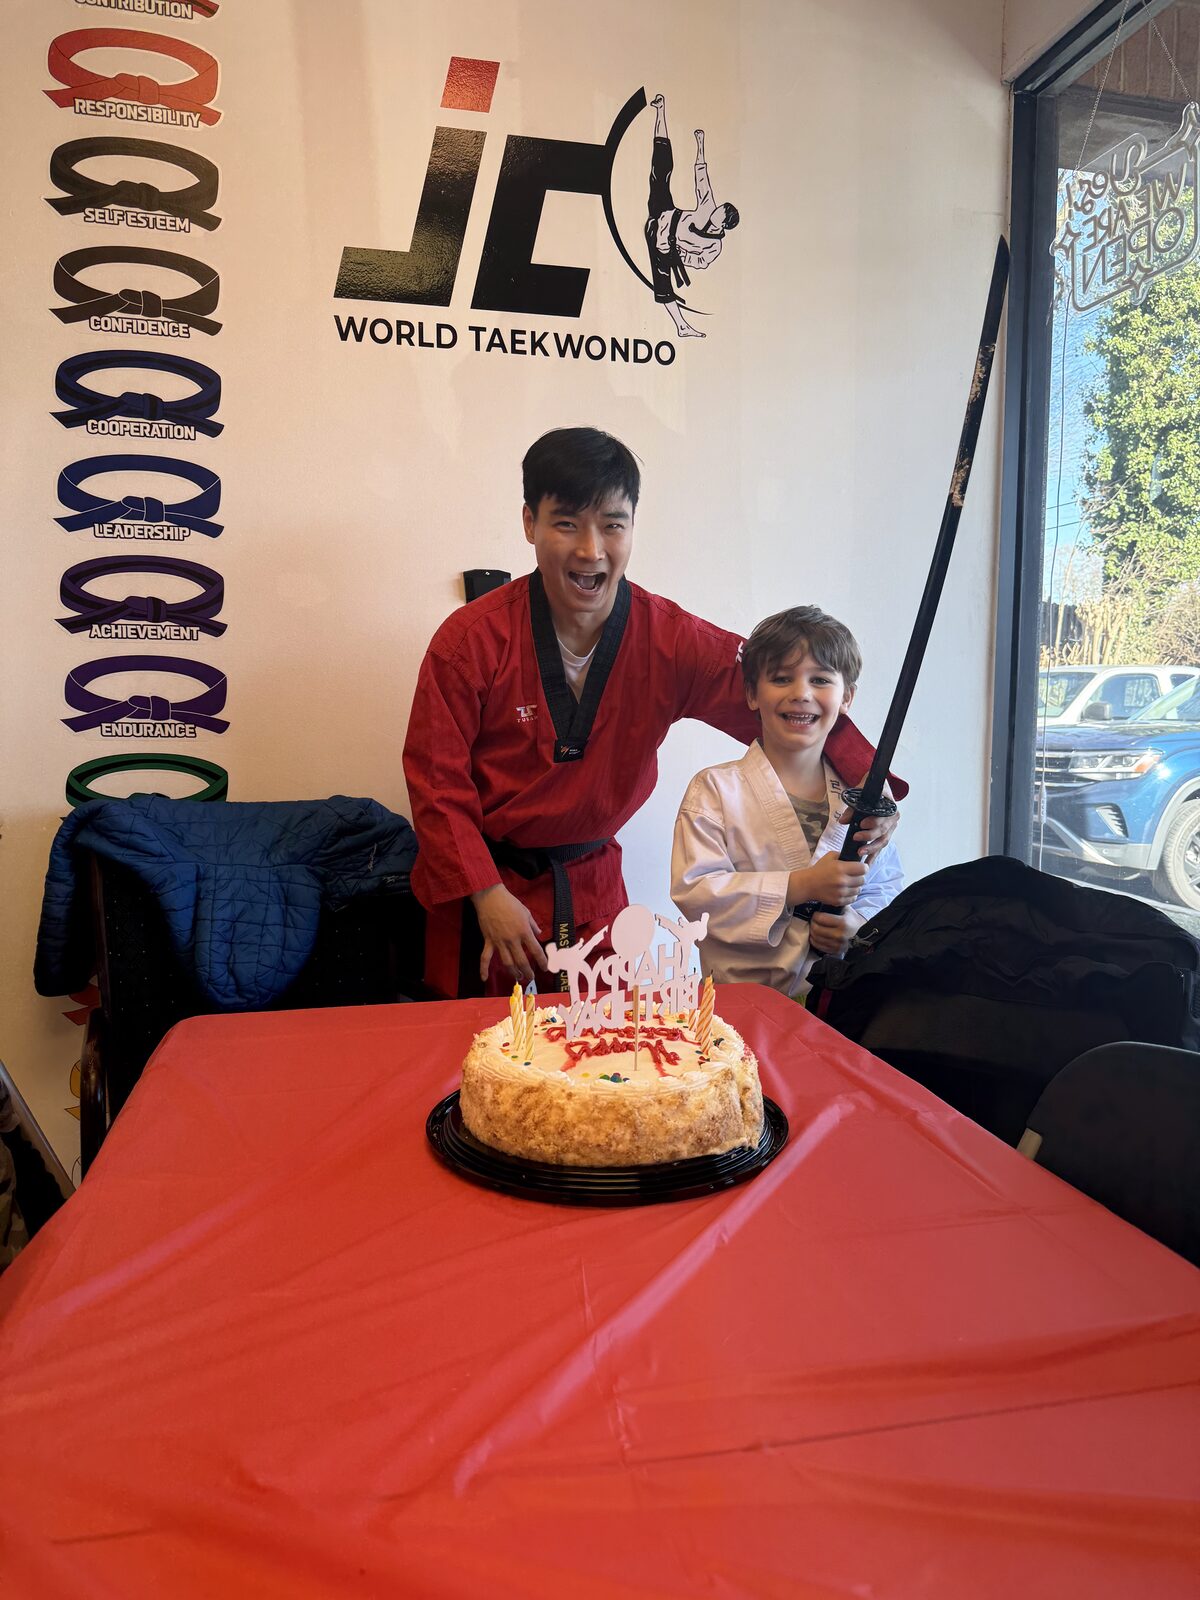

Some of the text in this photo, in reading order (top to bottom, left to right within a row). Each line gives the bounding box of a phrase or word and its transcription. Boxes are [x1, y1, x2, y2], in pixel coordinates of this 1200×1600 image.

[74, 98, 200, 128] RESPONSIBILITY
[84, 207, 190, 233] SELF ESTEEM
[89, 315, 190, 338] CONFIDENCE
[333, 314, 676, 367] WORLD TAEKWONDO
[86, 419, 196, 440] COOPERATION
[94, 522, 190, 541] LEADERSHIP
[89, 623, 200, 641] ACHIEVEMENT
[101, 722, 196, 738] ENDURANCE
